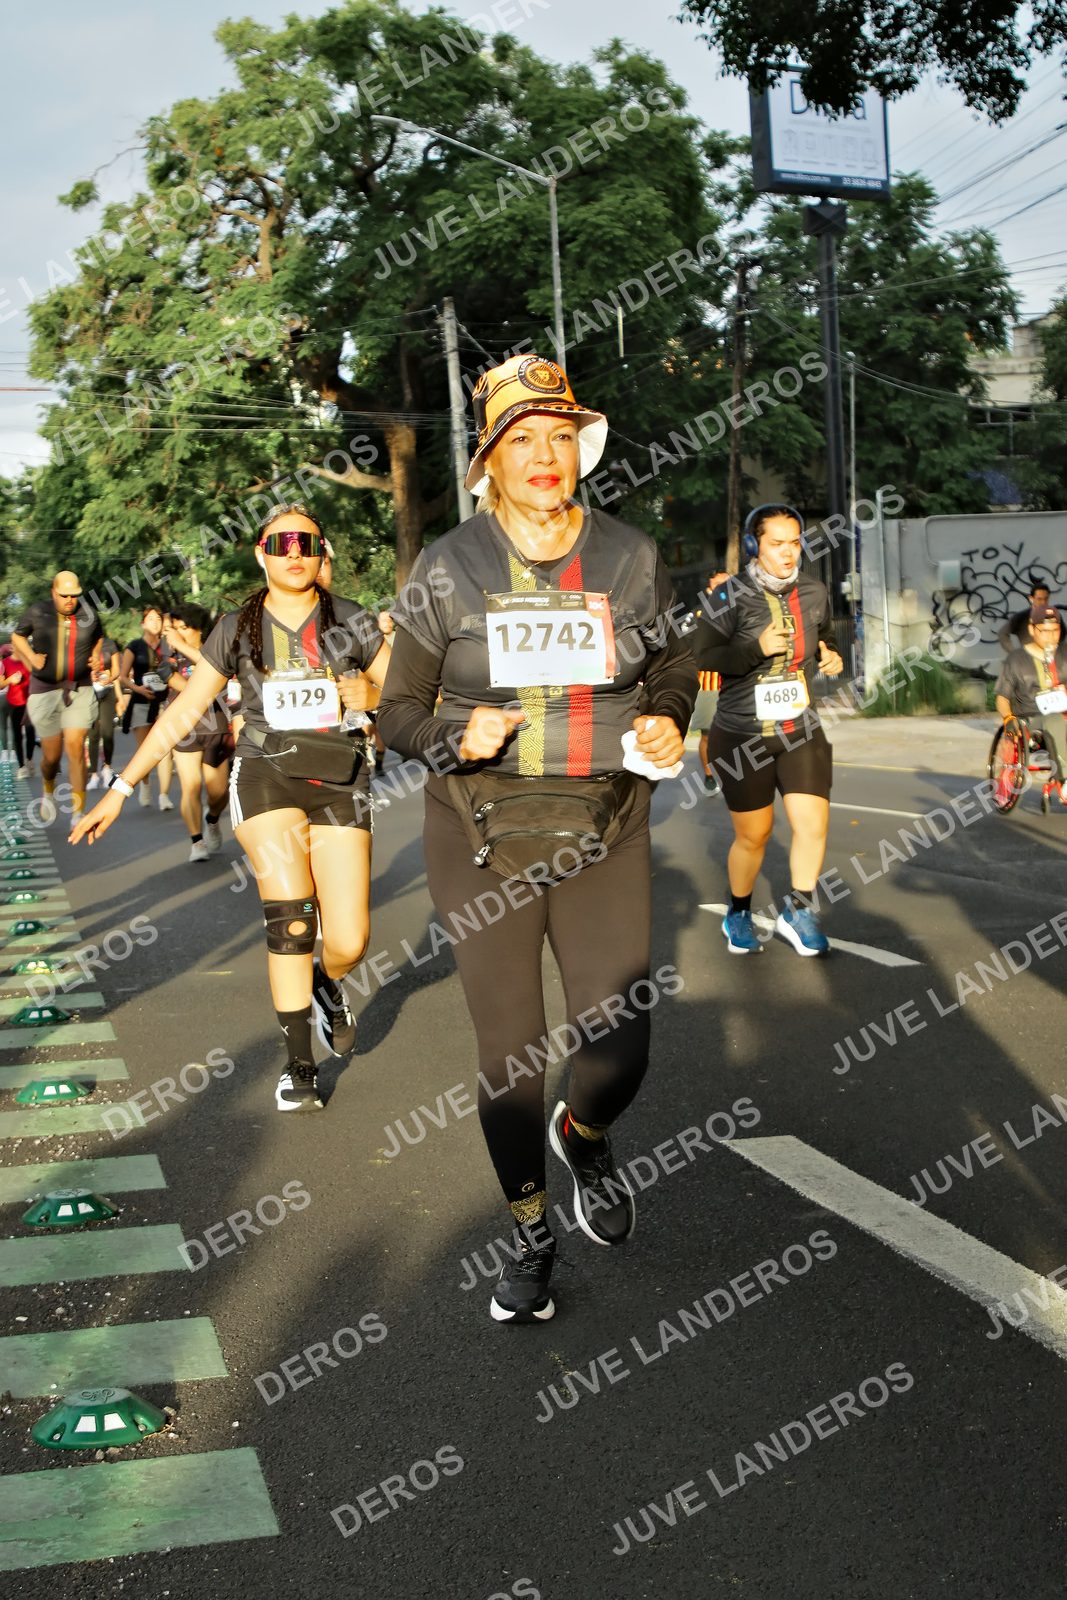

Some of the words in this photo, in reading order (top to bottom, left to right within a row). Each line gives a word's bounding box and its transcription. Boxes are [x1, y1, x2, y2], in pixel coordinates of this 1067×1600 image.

[961, 542, 1024, 566] TOY
[495, 621, 596, 652] 12742
[275, 688, 326, 709] 3129
[763, 687, 798, 704] 4689
